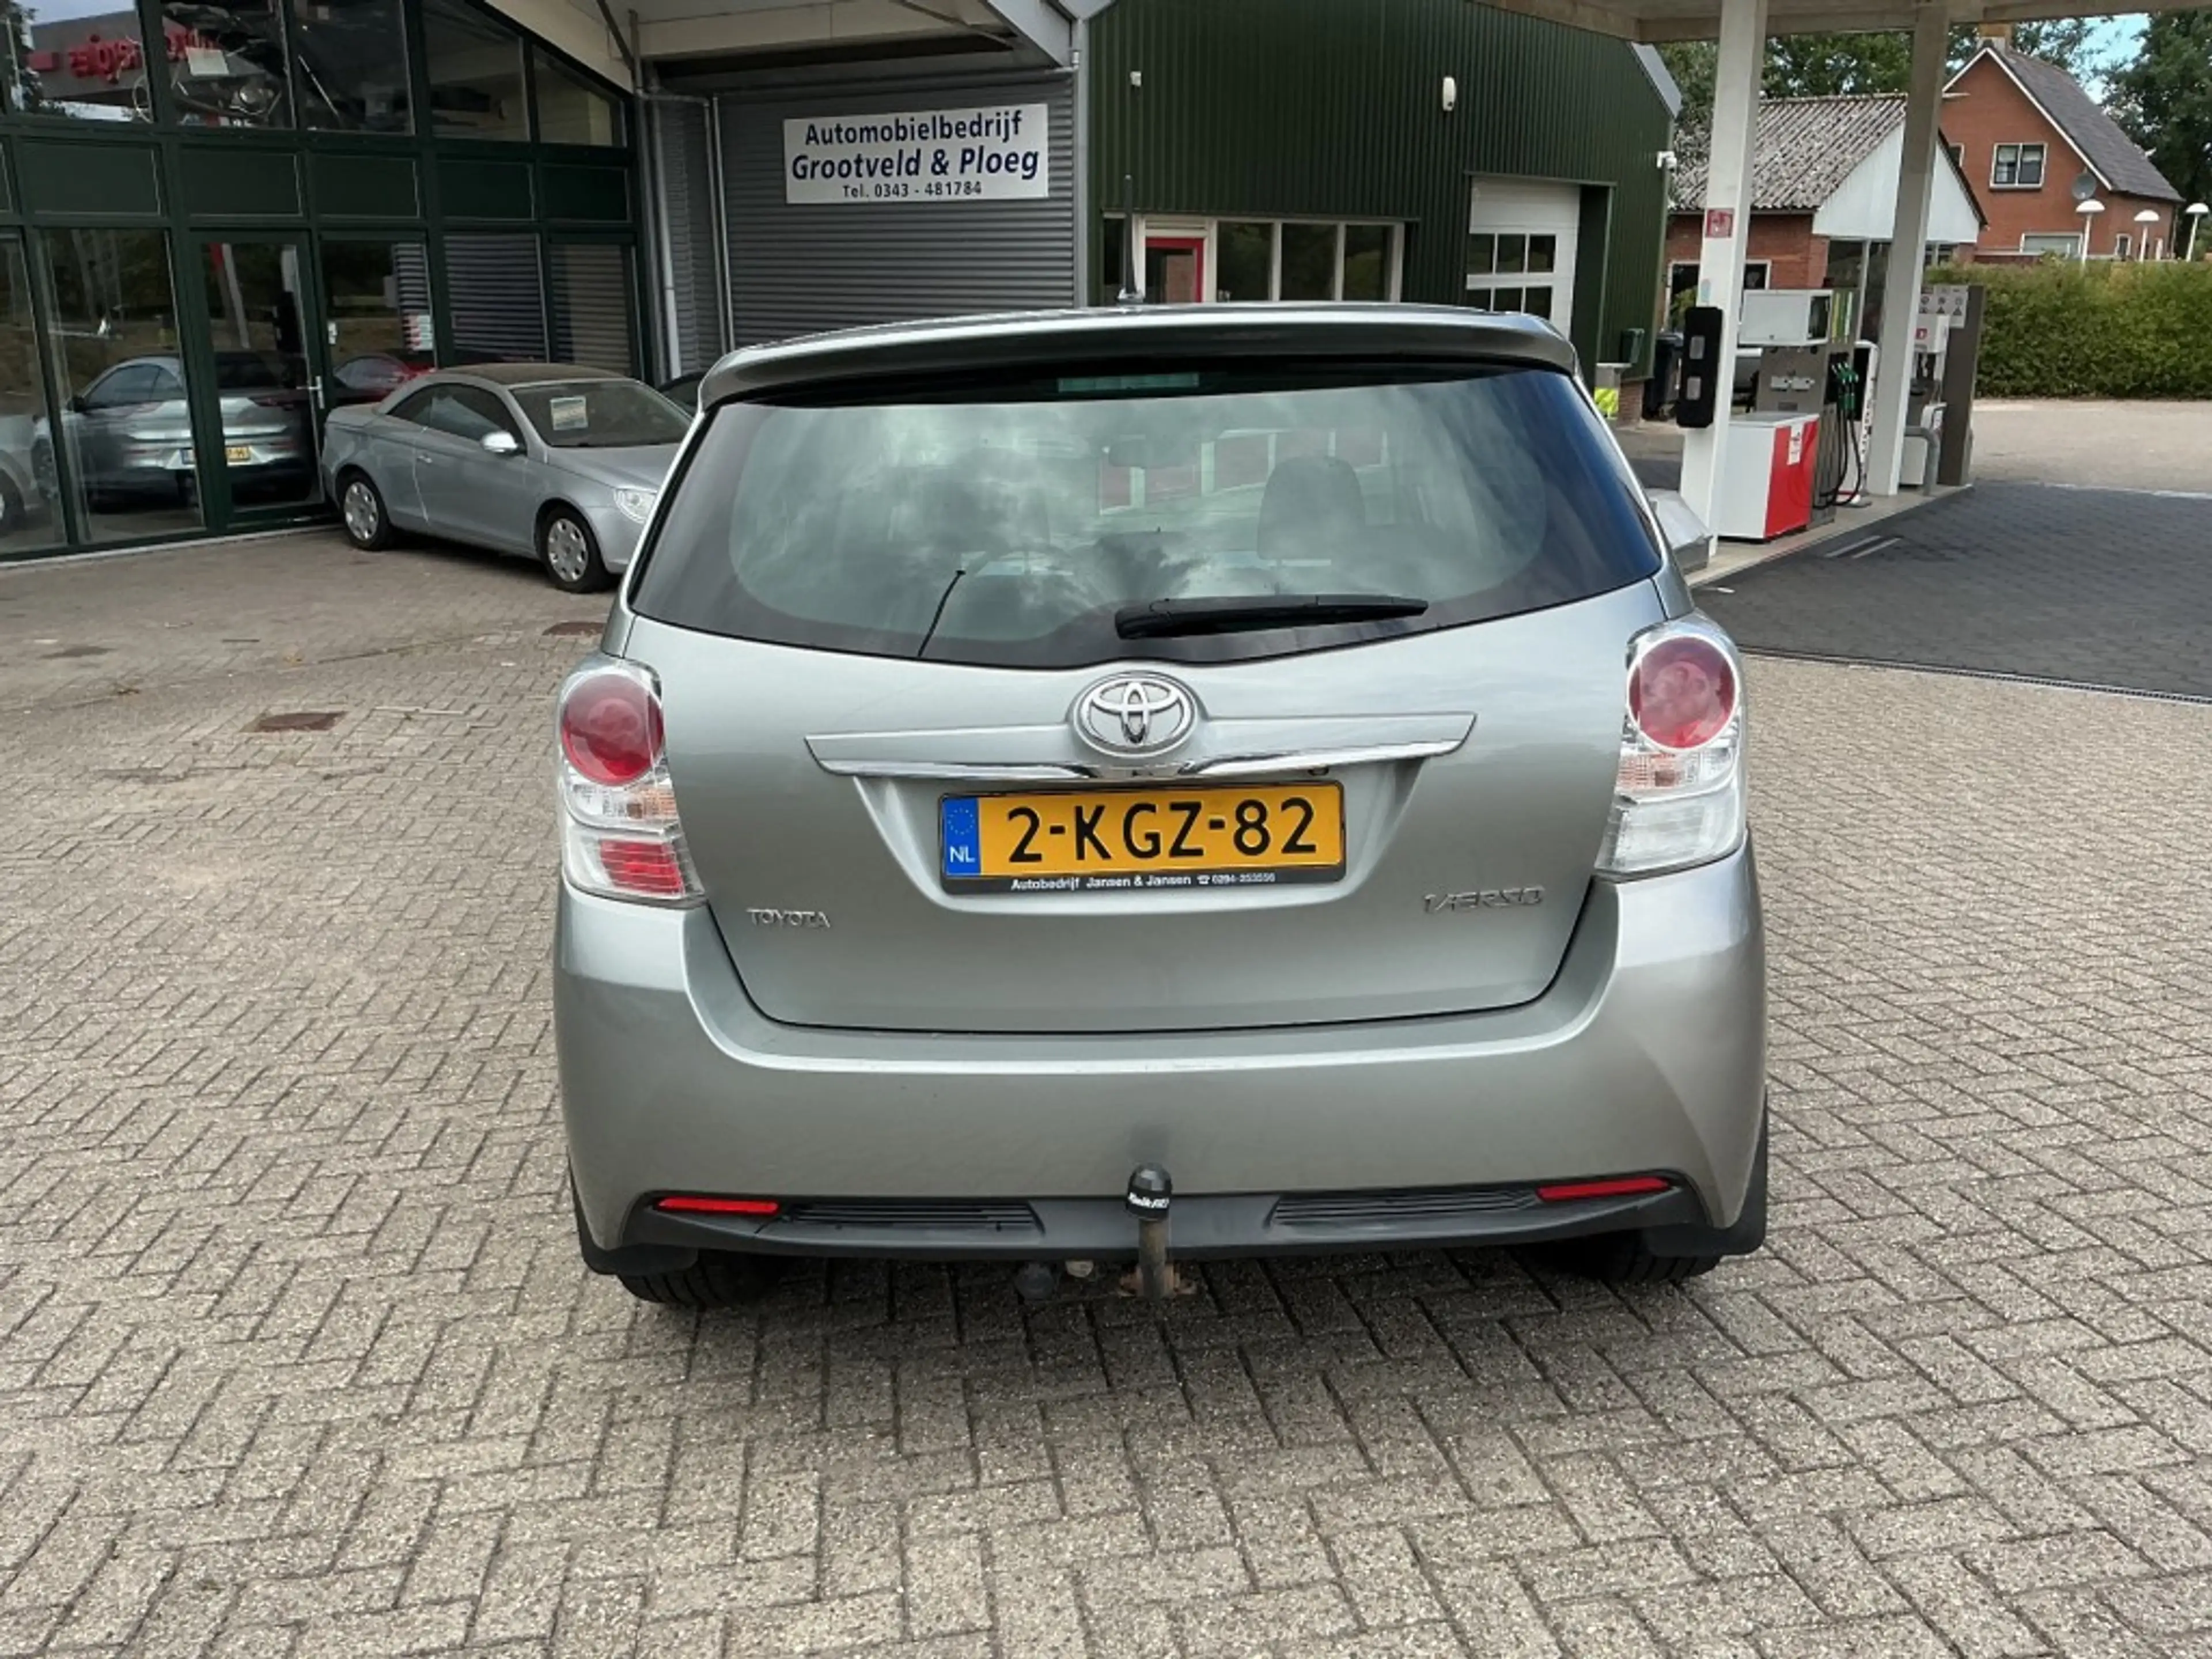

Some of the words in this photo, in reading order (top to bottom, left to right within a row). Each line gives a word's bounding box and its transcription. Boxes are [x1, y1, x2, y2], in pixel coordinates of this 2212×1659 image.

[805, 109, 1023, 146] Automobielbedrijf
[791, 148, 922, 180] Grootveld
[930, 149, 949, 175] &
[959, 146, 1040, 179] Ploeg
[842, 184, 869, 198] Tel.
[874, 184, 909, 197] 0343
[925, 181, 982, 196] 481784
[1007, 797, 1317, 863] 2-KGZ-82
[950, 846, 975, 863] NL
[1011, 877, 1080, 891] Autobedrijf
[1086, 875, 1131, 888] Jansen
[1134, 876, 1144, 886] &
[1146, 873, 1191, 885] Jansen
[1424, 886, 1545, 913] VERSO
[747, 908, 831, 928] TOYOTA
